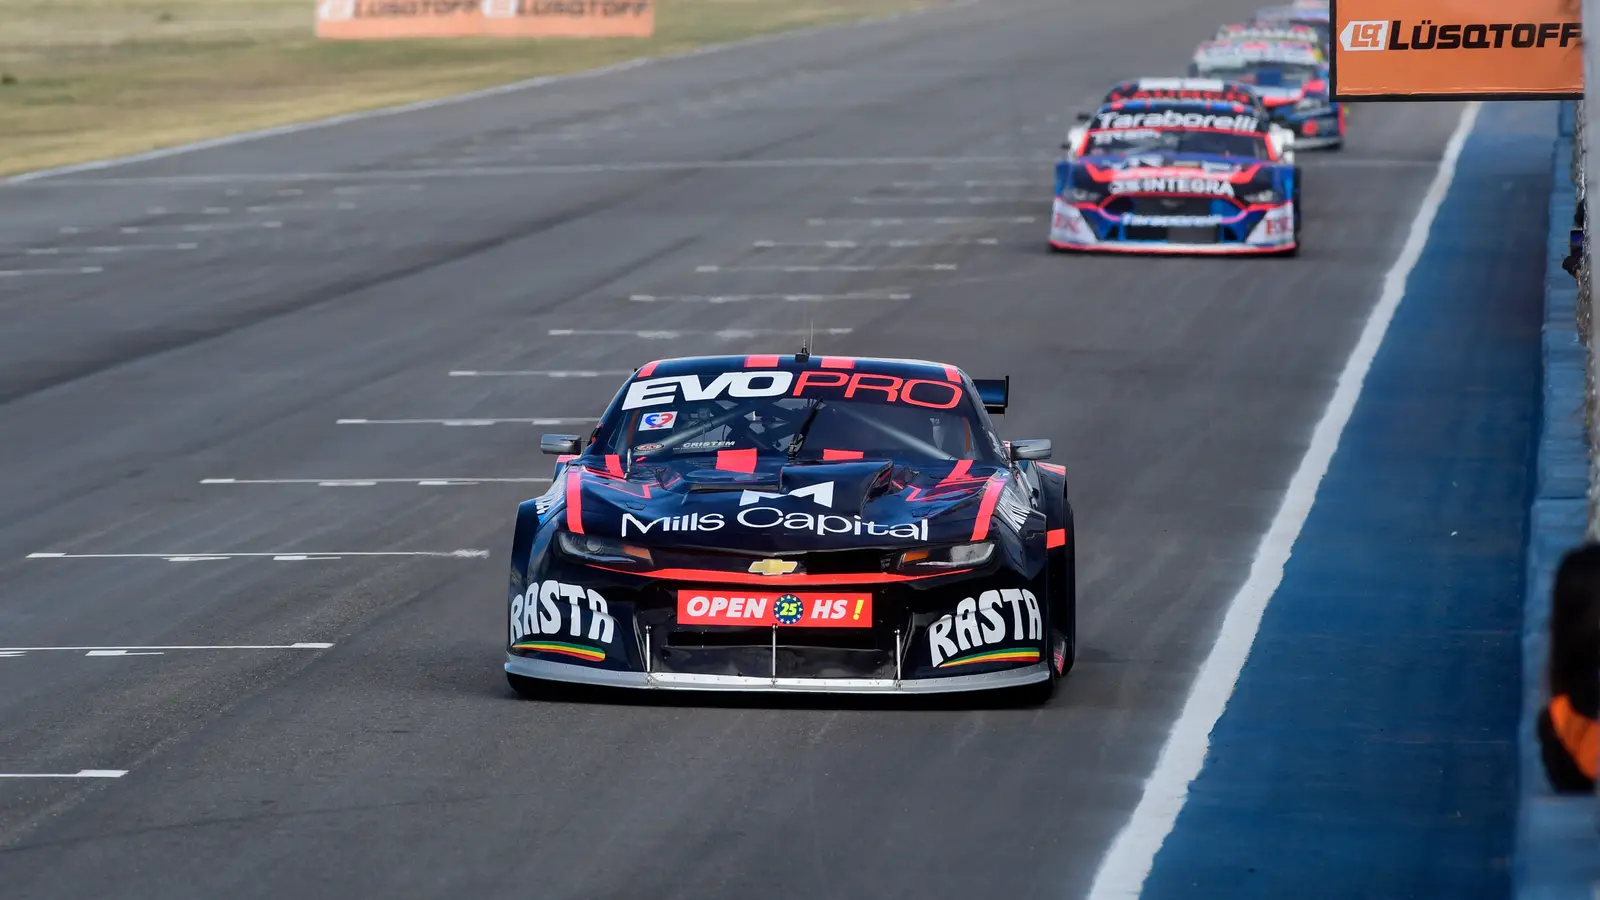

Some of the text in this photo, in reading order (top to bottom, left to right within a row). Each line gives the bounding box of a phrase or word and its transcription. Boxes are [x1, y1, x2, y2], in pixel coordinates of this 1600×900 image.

[1388, 20, 1582, 51] LÜSQTOFF
[1098, 110, 1260, 132] Taraborelli
[682, 440, 736, 449] CRISTEM
[621, 507, 929, 541] Mills Capital
[510, 579, 615, 646] RASTA
[686, 595, 767, 619] OPEN
[779, 602, 798, 616] 25
[929, 587, 1043, 668] RASTA
